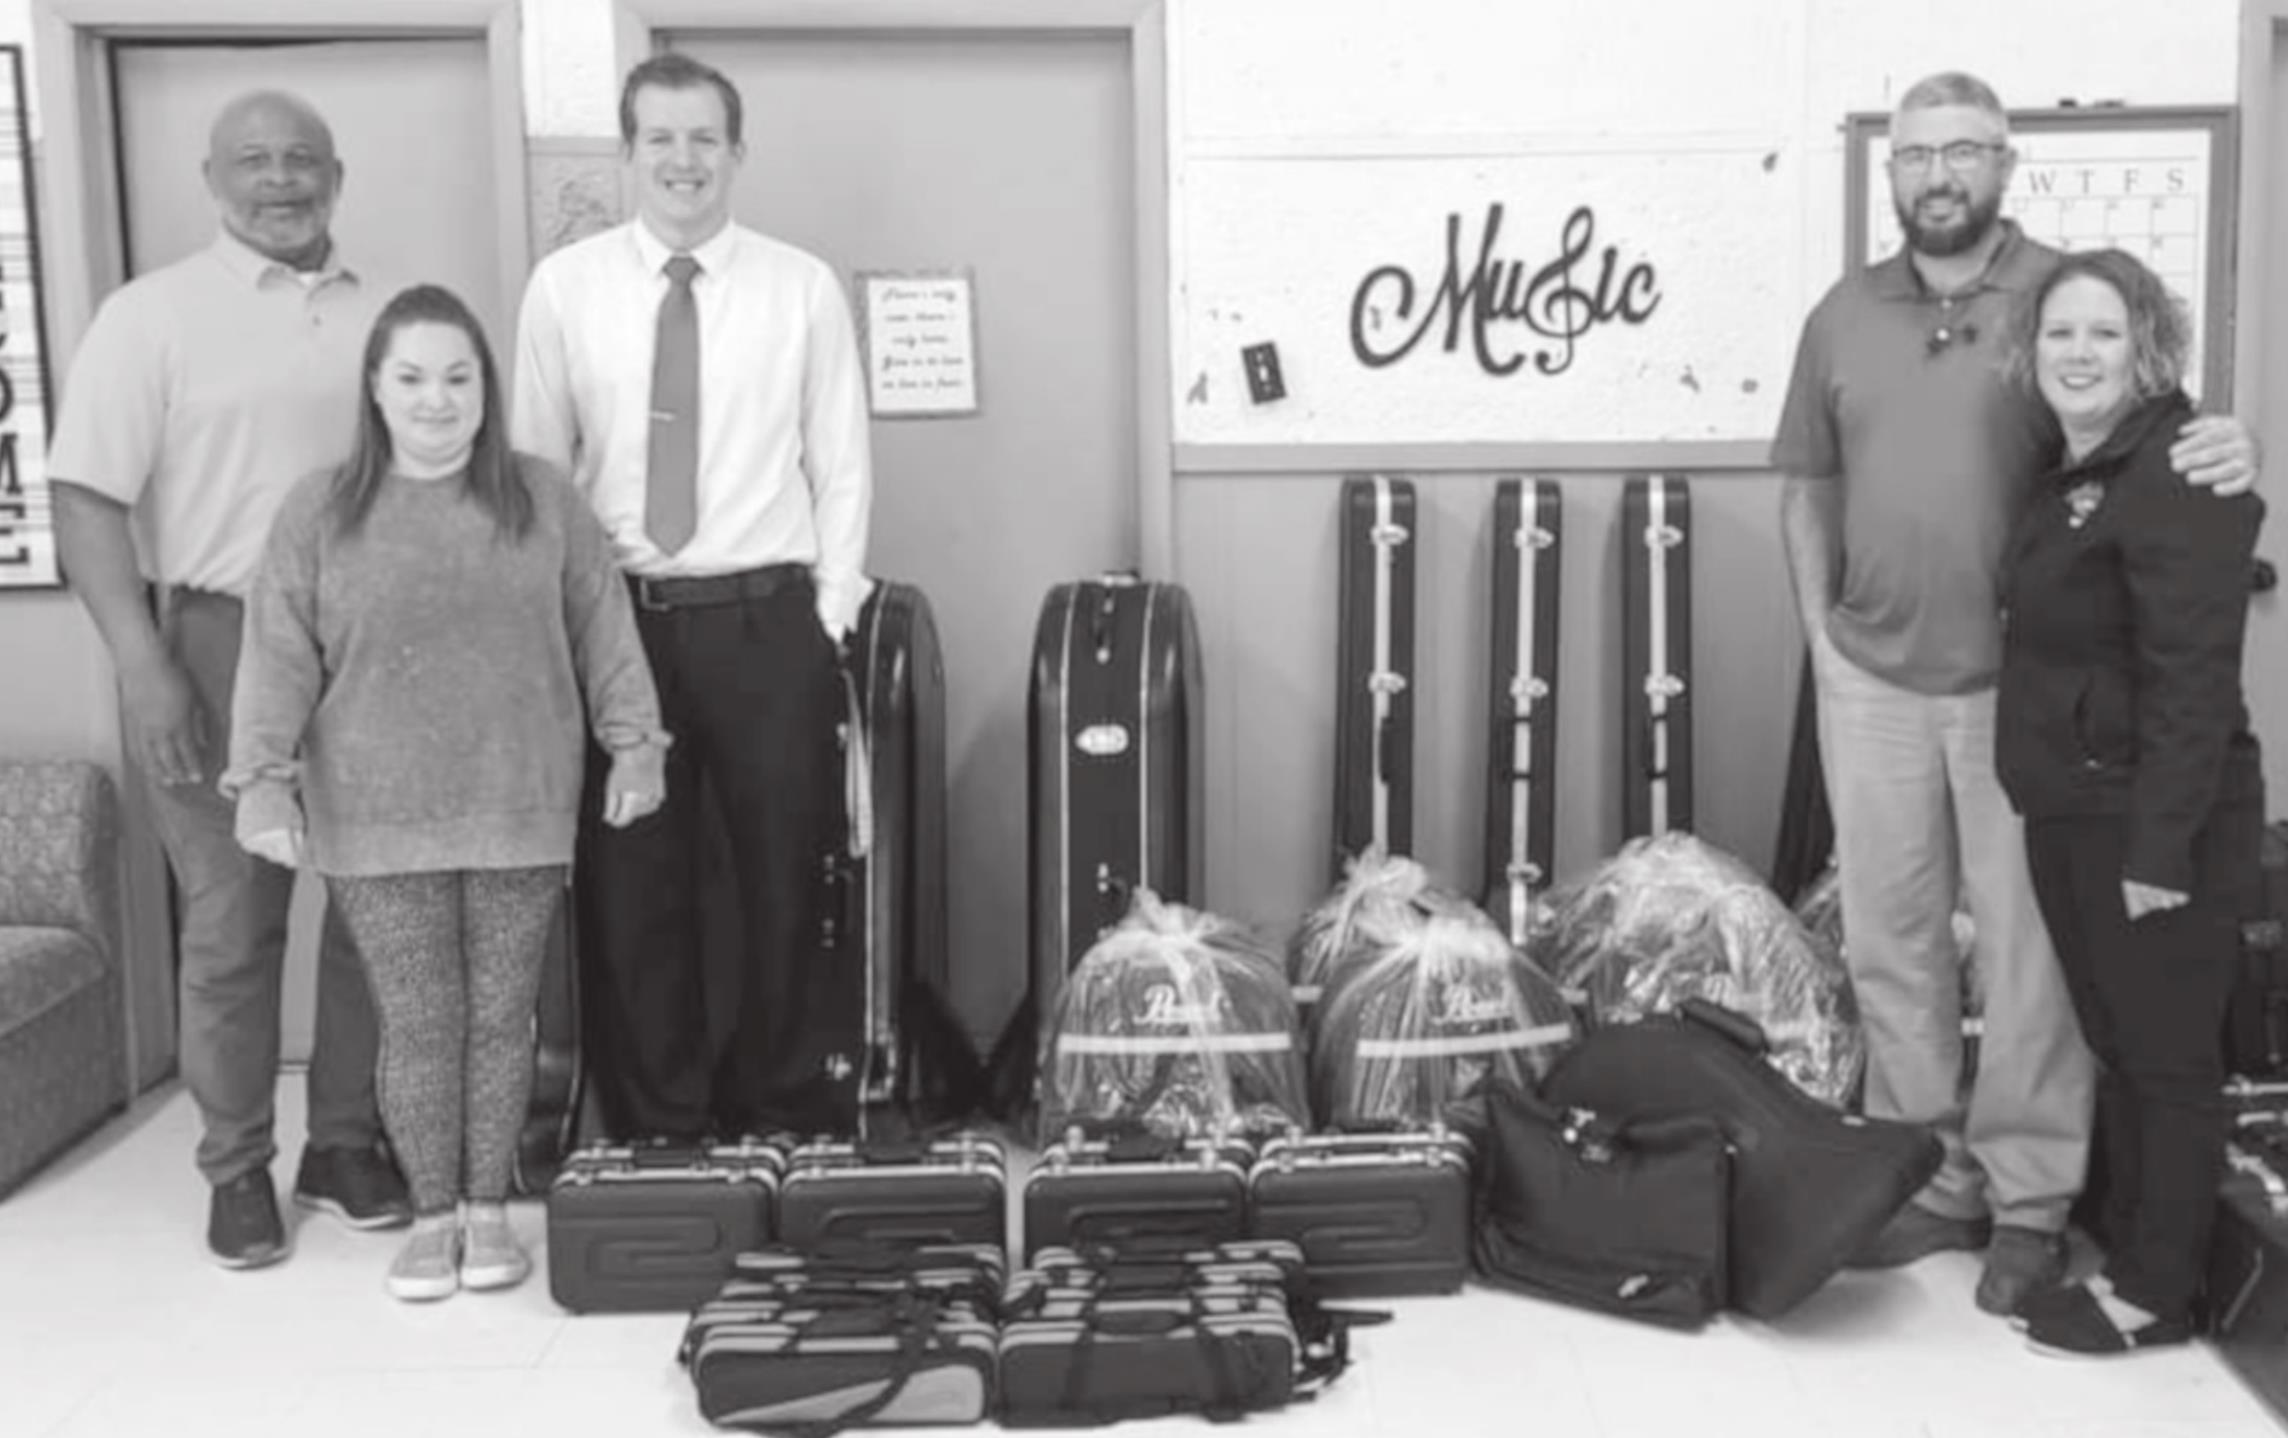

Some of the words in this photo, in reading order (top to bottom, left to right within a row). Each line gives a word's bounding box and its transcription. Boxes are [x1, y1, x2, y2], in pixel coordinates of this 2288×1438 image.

[2028, 168, 2057, 194] W
[2075, 168, 2096, 194] T
[2123, 168, 2140, 194] F
[2165, 168, 2184, 193] S
